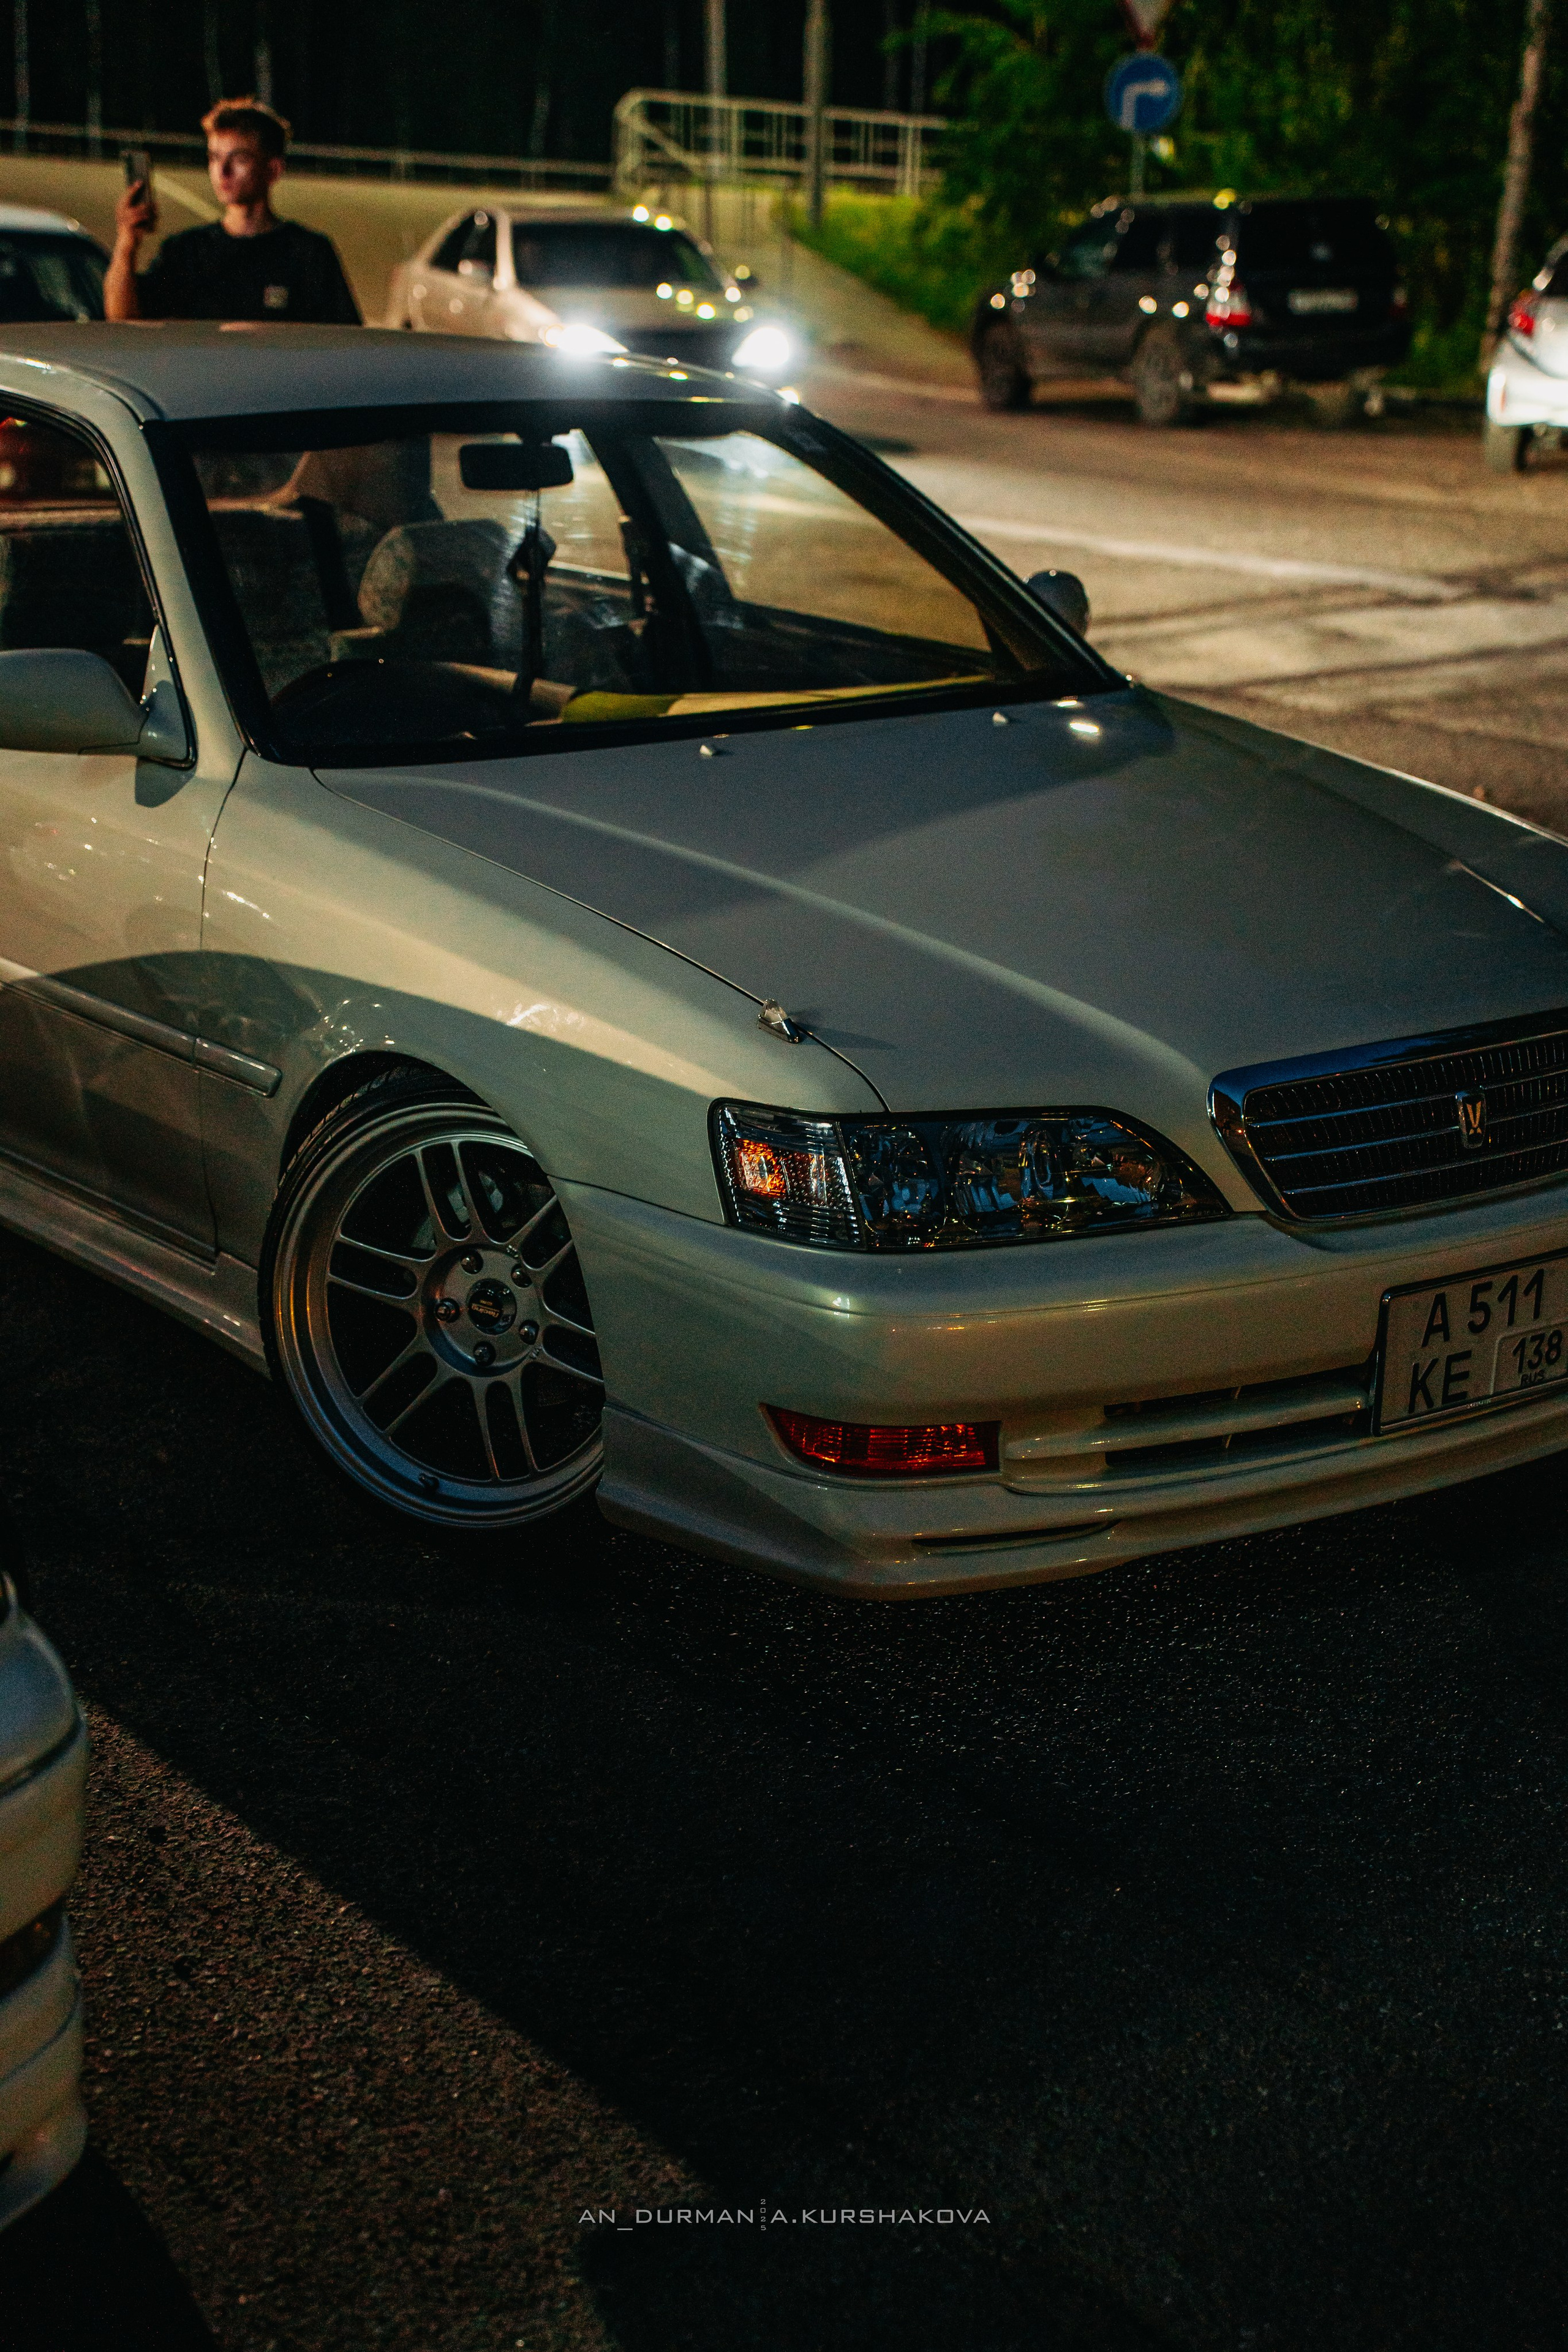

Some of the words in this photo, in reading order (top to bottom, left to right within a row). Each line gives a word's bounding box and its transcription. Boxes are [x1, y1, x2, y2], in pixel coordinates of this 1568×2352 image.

[1421, 1292, 1450, 1348] A
[1468, 1268, 1544, 1333] 511
[1512, 1330, 1562, 1373] 138
[1409, 1350, 1472, 1414] KE
[1521, 1370, 1545, 1387] RUS
